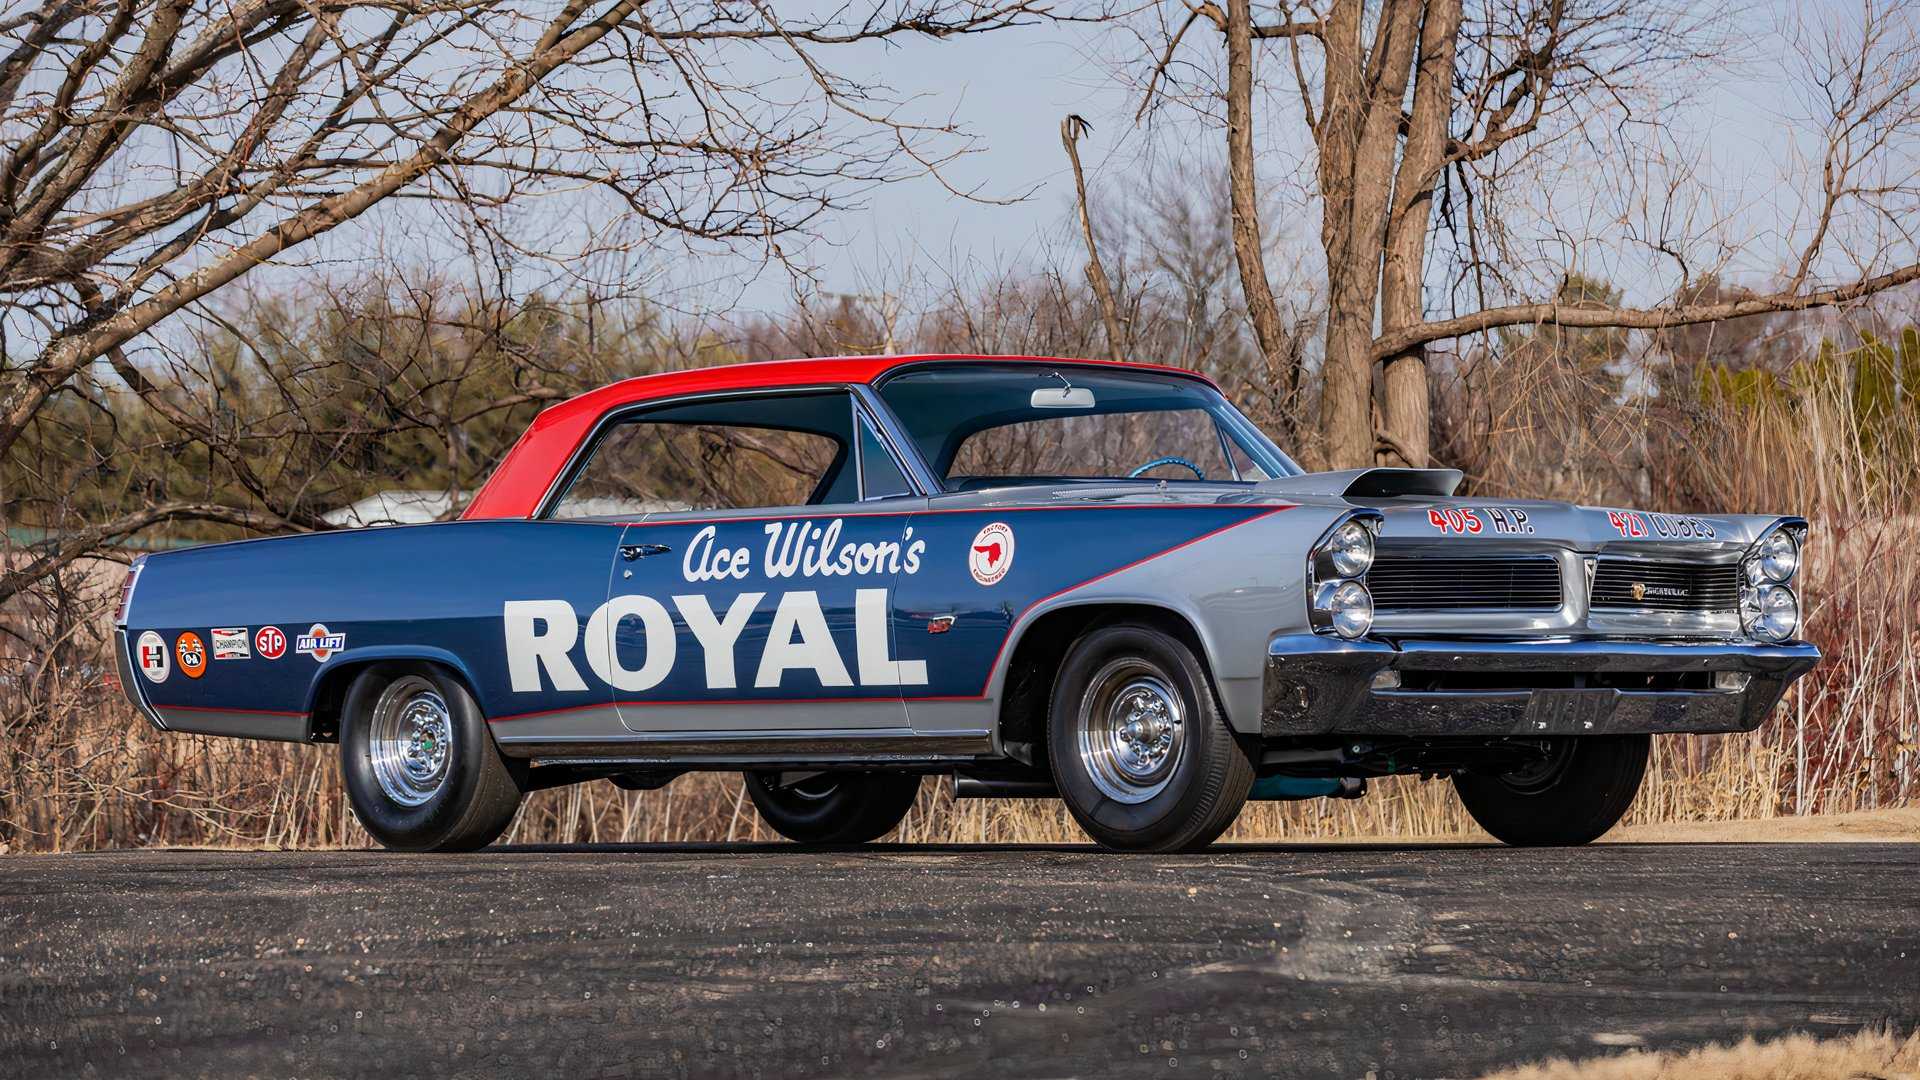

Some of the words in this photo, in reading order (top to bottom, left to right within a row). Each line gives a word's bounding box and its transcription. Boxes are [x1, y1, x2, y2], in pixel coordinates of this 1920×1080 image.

[1427, 508, 1483, 534] 405
[1483, 508, 1534, 534] H.P.
[1607, 512, 1648, 537] 421
[1647, 512, 1716, 539] CUBES
[682, 525, 750, 582] Ace
[764, 519, 926, 579] Wilson's
[215, 639, 247, 649] CHAMPION
[259, 630, 283, 653] STP
[299, 636, 317, 649] AIR
[319, 635, 342, 648] LIFT
[504, 588, 929, 692] ROYAL
